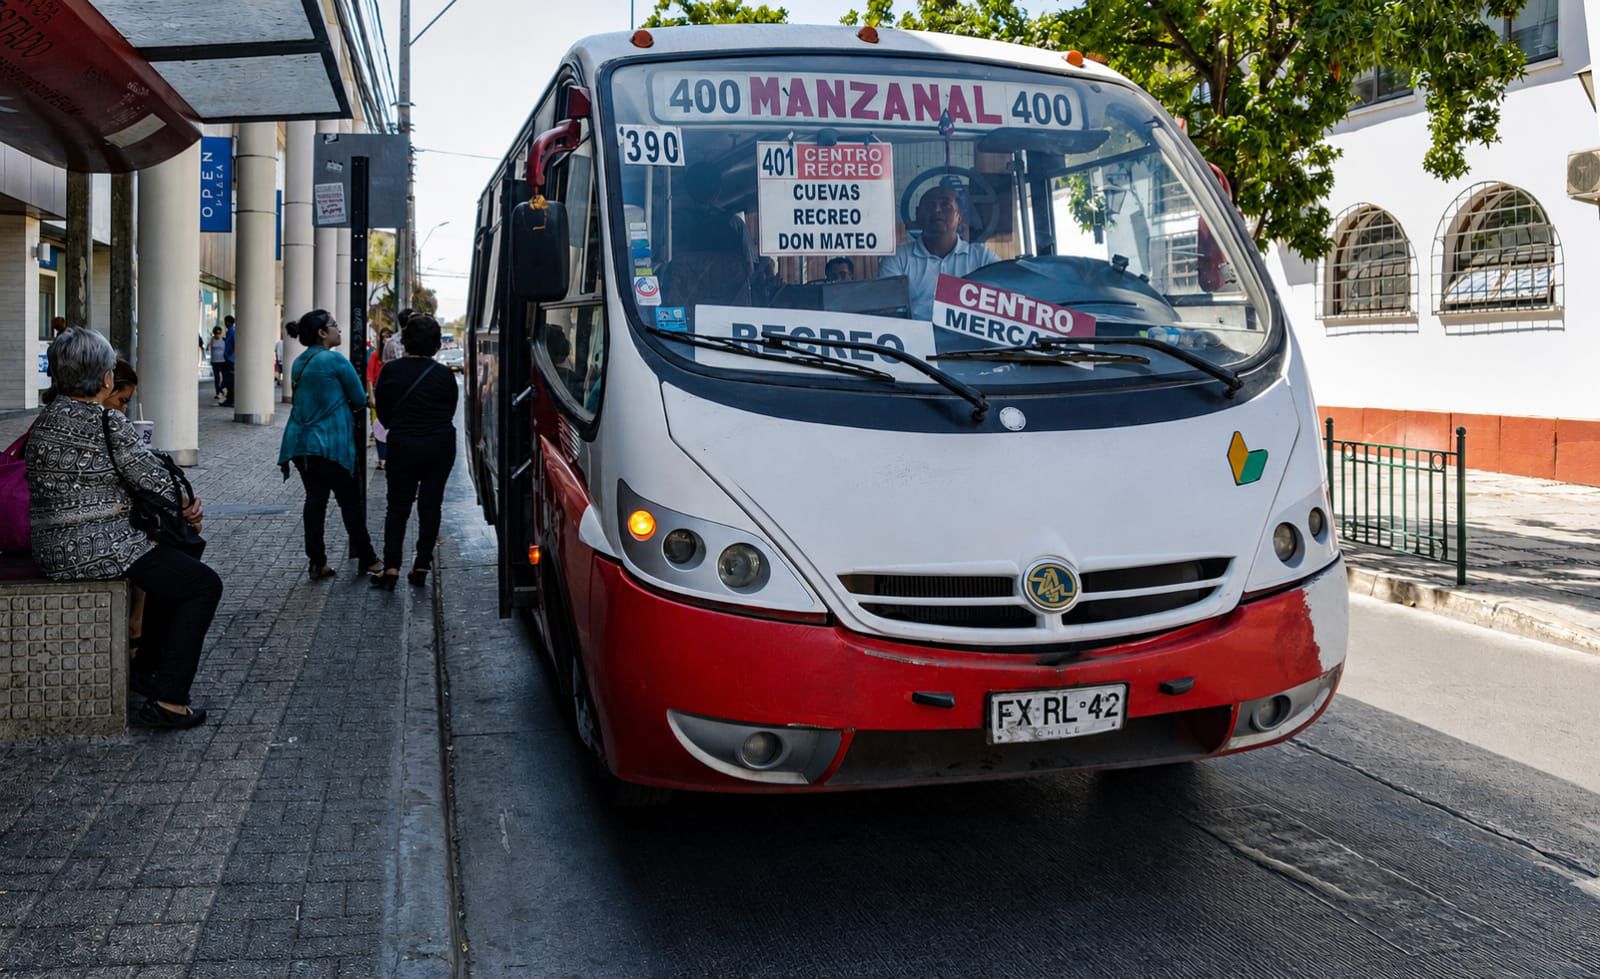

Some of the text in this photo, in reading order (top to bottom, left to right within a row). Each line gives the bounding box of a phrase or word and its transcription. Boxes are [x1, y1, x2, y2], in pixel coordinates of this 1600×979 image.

[669, 76, 1072, 127] 400 MANZANAL 400
[626, 130, 679, 163] 390
[804, 148, 882, 162] CENTRO
[762, 147, 794, 176] 401
[804, 163, 883, 177] RECREO
[202, 152, 213, 218] OPEN
[793, 183, 860, 201] CUEVAS
[793, 208, 861, 225] RECREO
[778, 232, 877, 250] DON MATEO
[959, 283, 1074, 333] CENTRO
[946, 308, 1074, 352] MERCA
[1037, 727, 1080, 738] CHILE
